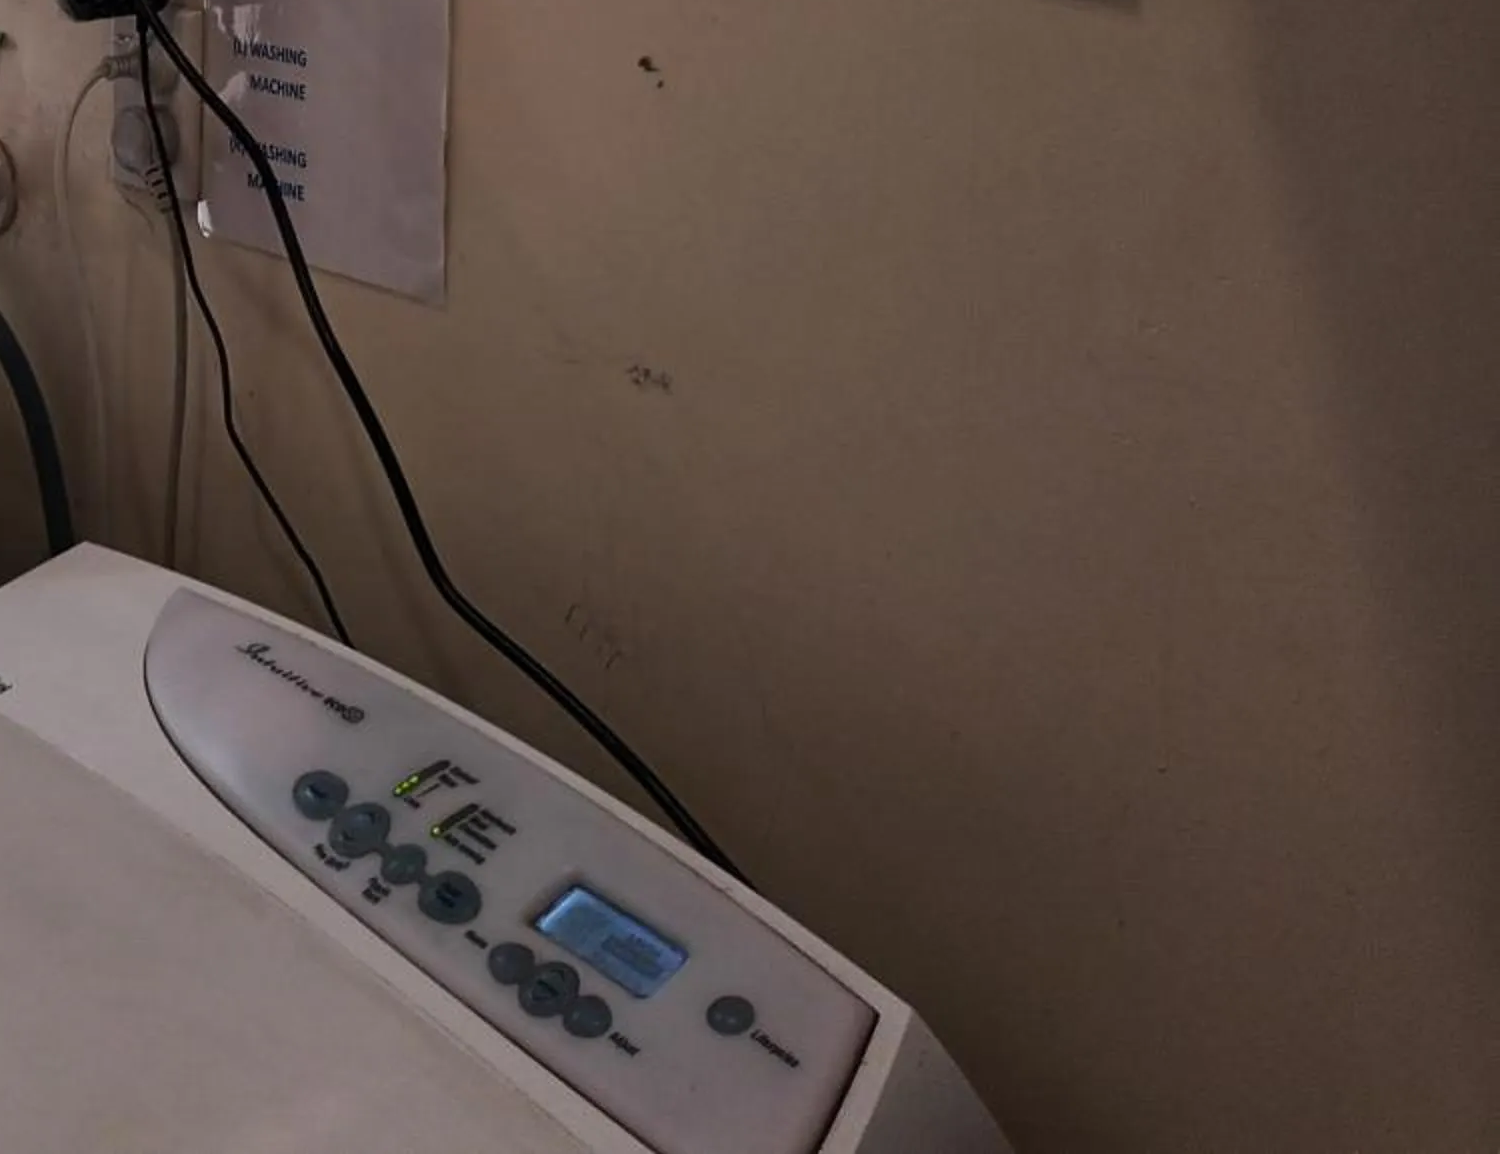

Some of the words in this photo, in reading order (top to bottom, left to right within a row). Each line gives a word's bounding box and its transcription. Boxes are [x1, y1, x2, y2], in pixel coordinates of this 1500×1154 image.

[249, 39, 307, 67] WASHING
[249, 73, 307, 100] MACHINE
[250, 141, 307, 169] ASHING
[247, 173, 306, 202] MINE
